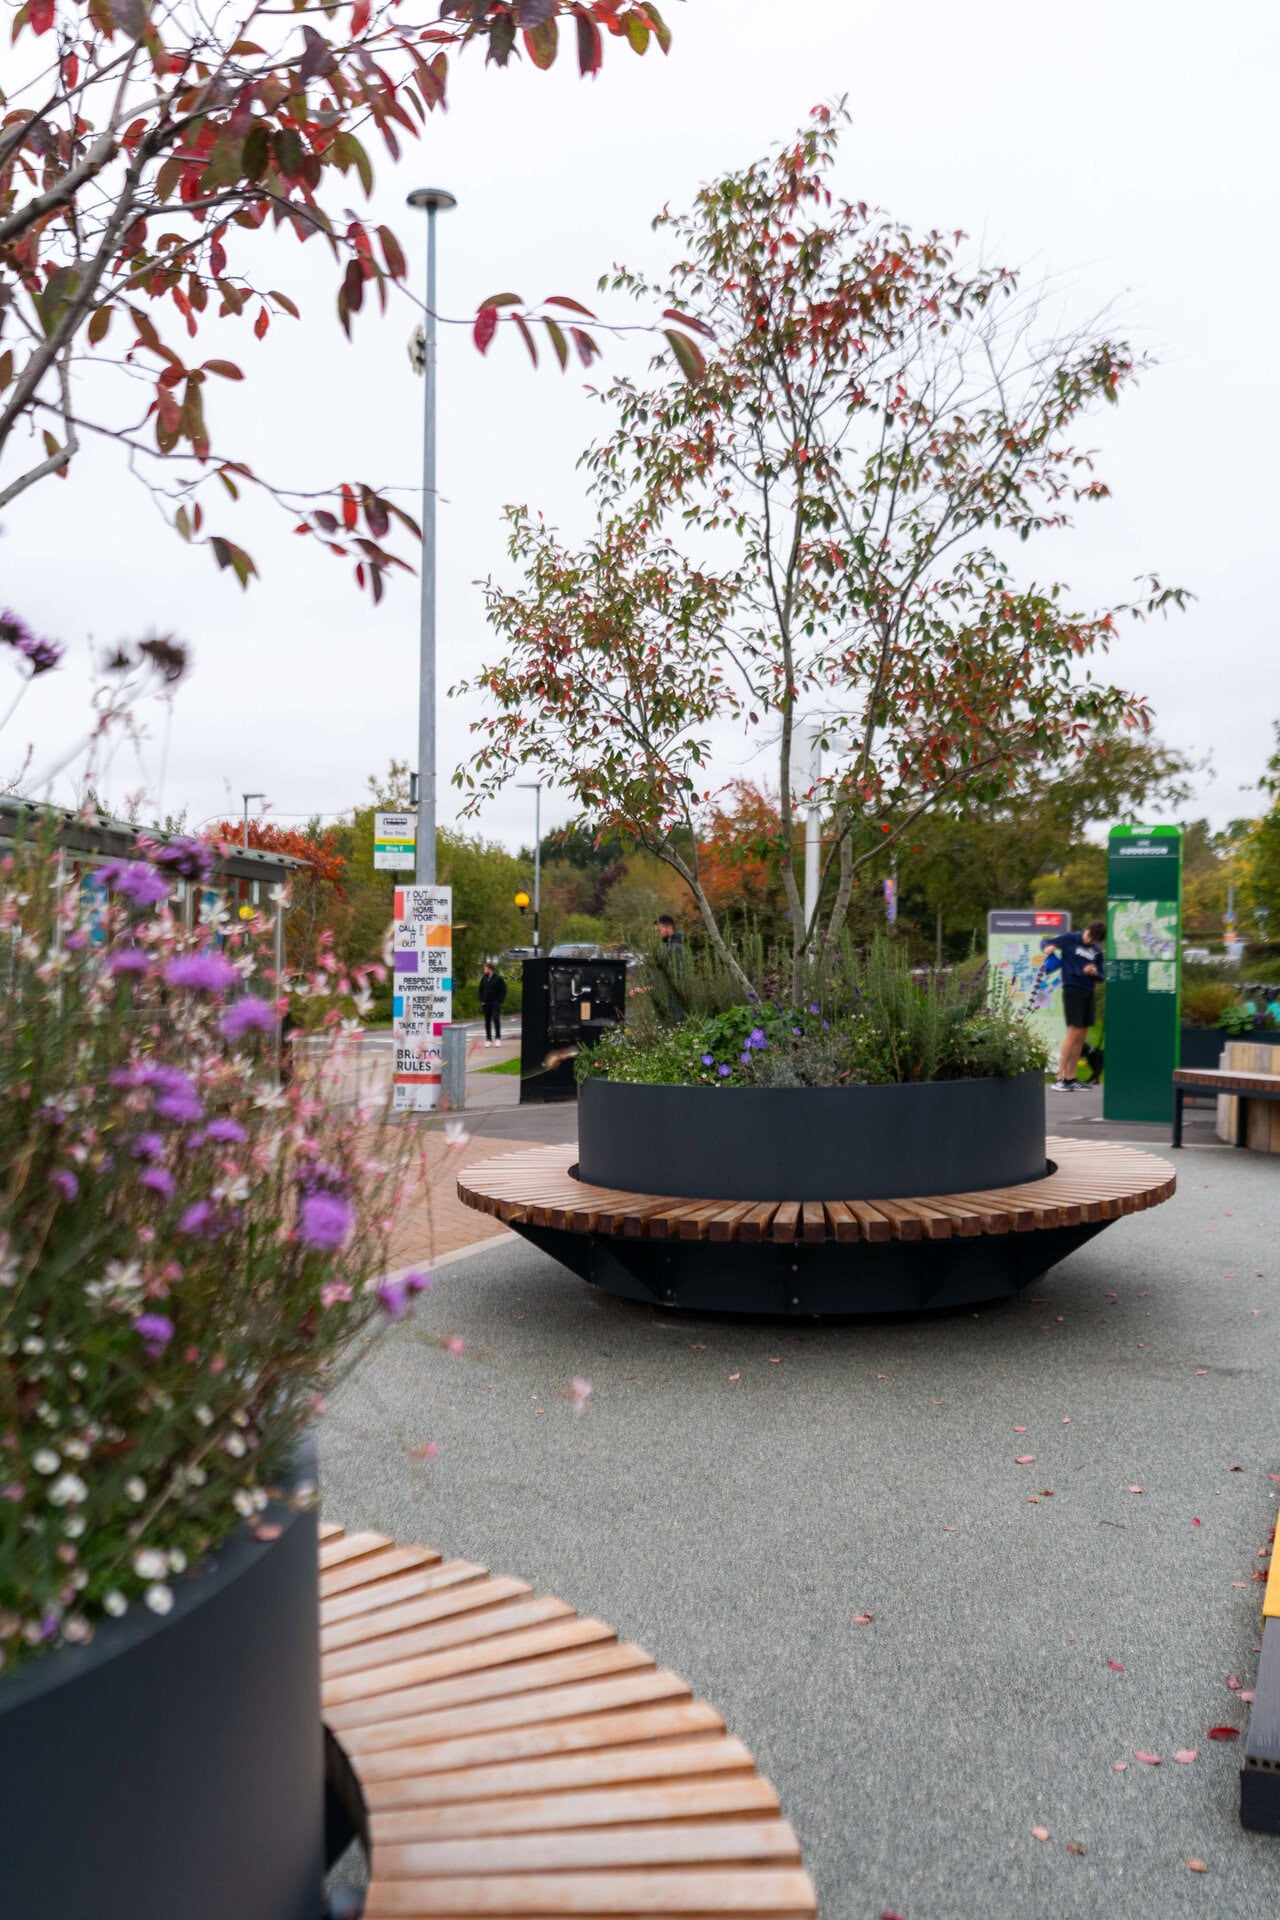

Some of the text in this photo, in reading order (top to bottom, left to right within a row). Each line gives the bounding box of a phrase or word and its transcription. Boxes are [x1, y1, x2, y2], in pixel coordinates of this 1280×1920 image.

[412, 890, 429, 898] OUT
[412, 898, 449, 906] TOGETHER
[412, 906, 434, 914] HOME
[398, 924, 417, 932] CALL
[410, 932, 416, 940] IT
[401, 940, 417, 948] OUT
[428, 951, 447, 959] DON'T
[403, 977, 435, 985] RESPECT
[412, 996, 431, 1004] KEEP
[427, 1011, 445, 1019] EDGE
[398, 1022, 424, 1030] TAKE IT
[396, 1060, 432, 1072] RULES
